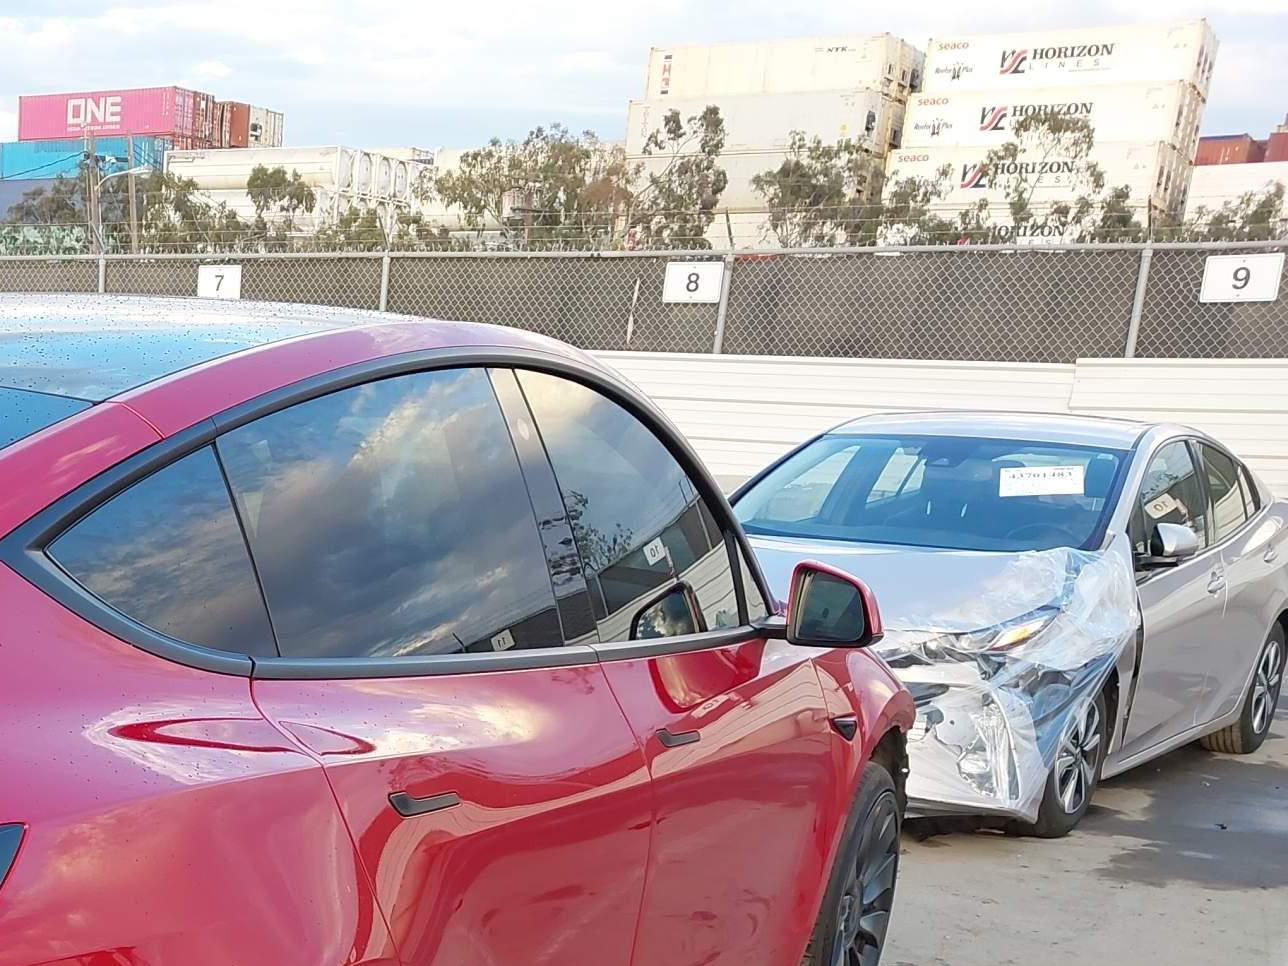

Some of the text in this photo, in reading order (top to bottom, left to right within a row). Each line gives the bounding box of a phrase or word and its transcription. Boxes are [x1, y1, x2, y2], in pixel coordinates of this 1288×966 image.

[938, 41, 969, 50] seaco
[1031, 43, 1115, 60] HORIZON
[1029, 59, 1101, 71] LINES
[918, 97, 949, 106] seaco
[67, 96, 121, 123] ONE
[1011, 102, 1093, 117] HORIZON
[898, 154, 929, 163] seaco
[995, 161, 1075, 175] HORIZON
[215, 274, 225, 291] 7
[686, 272, 700, 293] 8
[1232, 267, 1251, 290] 9
